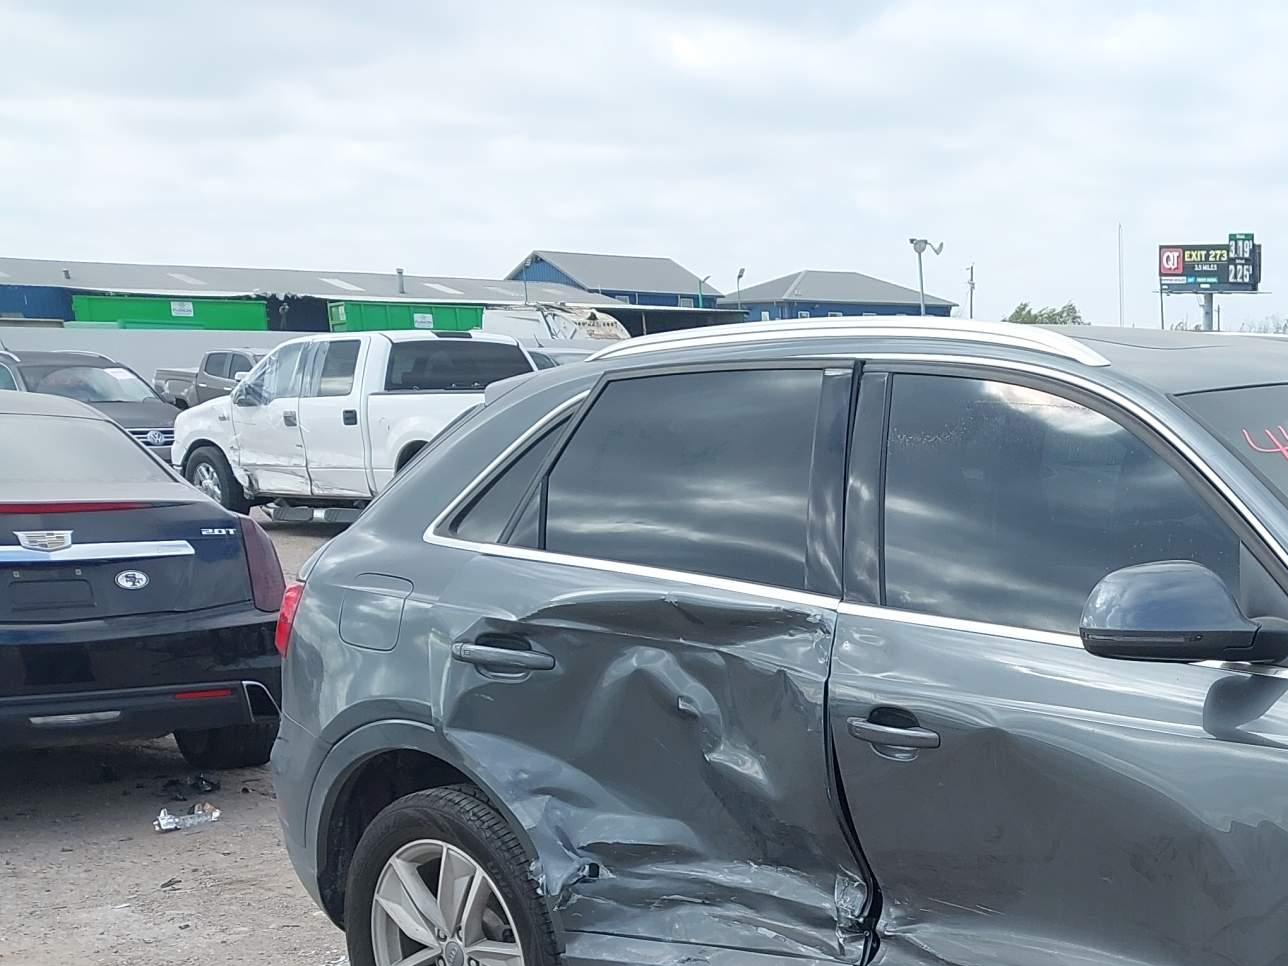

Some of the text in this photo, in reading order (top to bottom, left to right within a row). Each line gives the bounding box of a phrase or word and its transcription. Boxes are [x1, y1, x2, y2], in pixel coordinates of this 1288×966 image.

[1162, 251, 1179, 270] QT
[1184, 249, 1227, 261] EXIT 273
